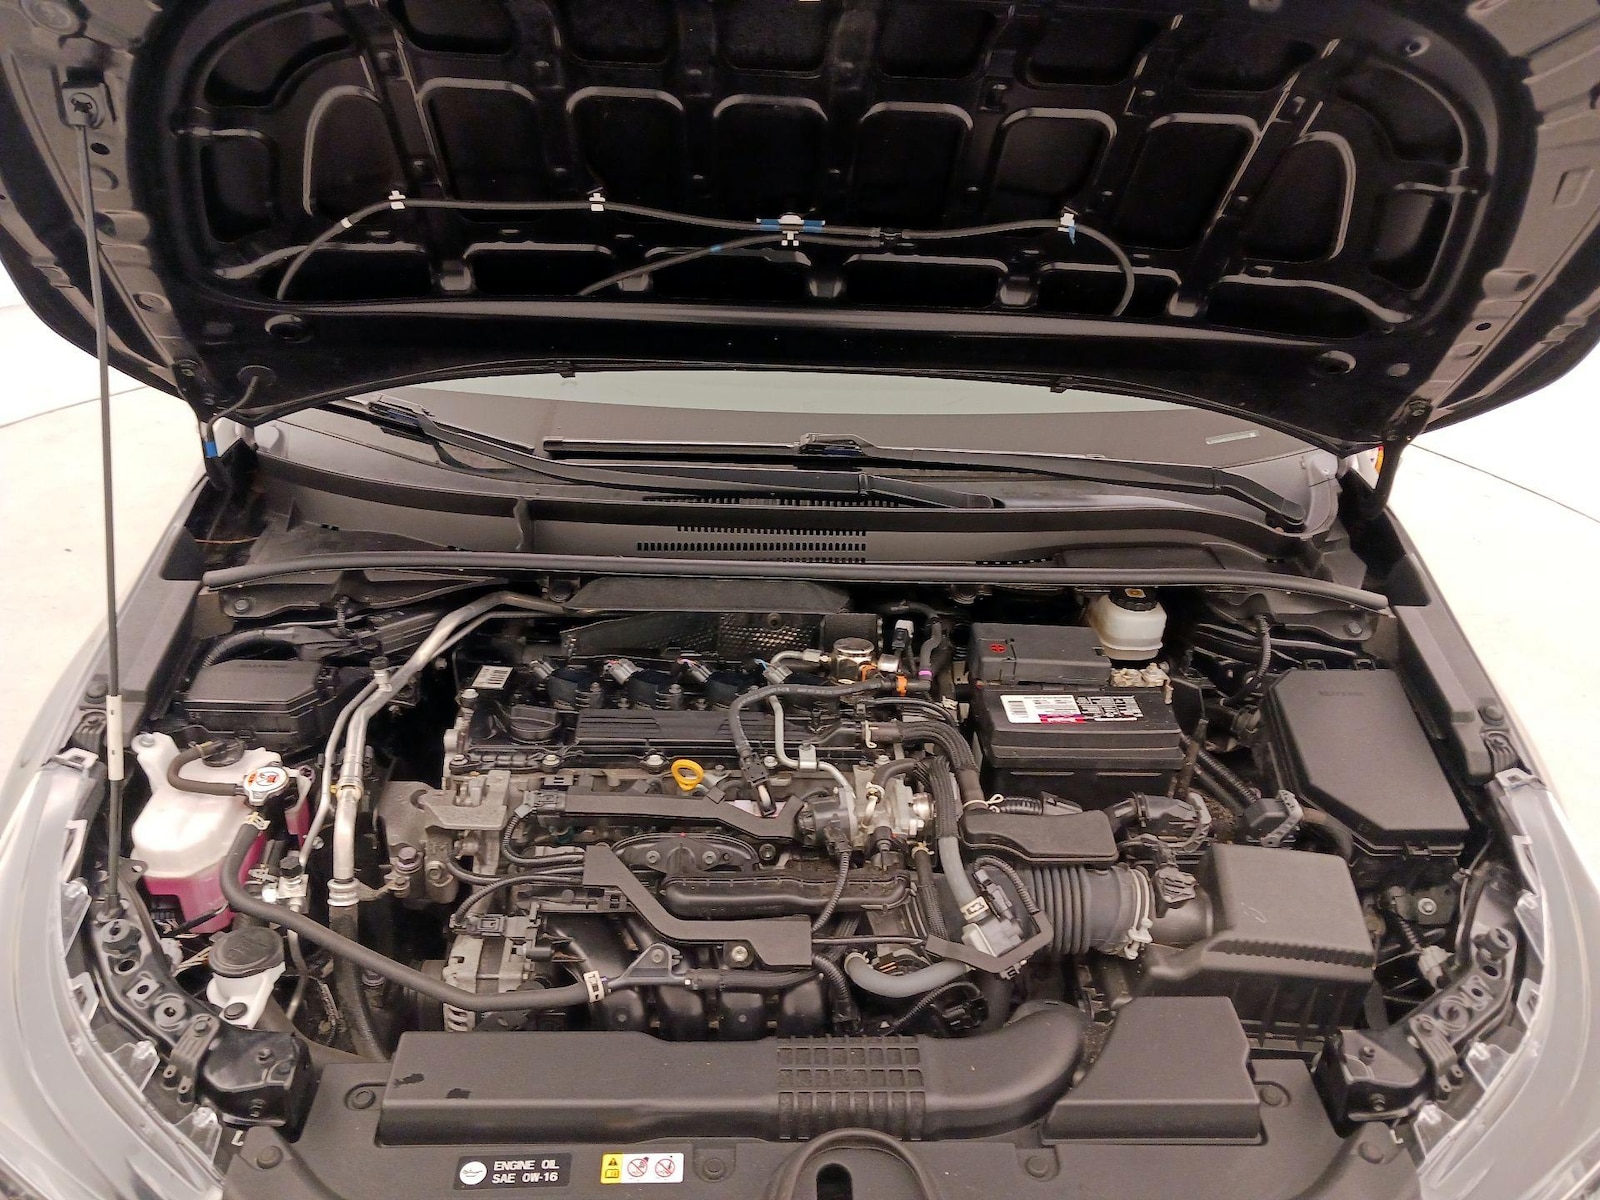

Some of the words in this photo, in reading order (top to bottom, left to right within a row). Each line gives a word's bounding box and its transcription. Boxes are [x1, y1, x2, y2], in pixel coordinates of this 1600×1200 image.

[493, 1160, 536, 1171] ENGINE
[541, 1159, 560, 1170] OIL
[491, 1173, 517, 1184] SAE
